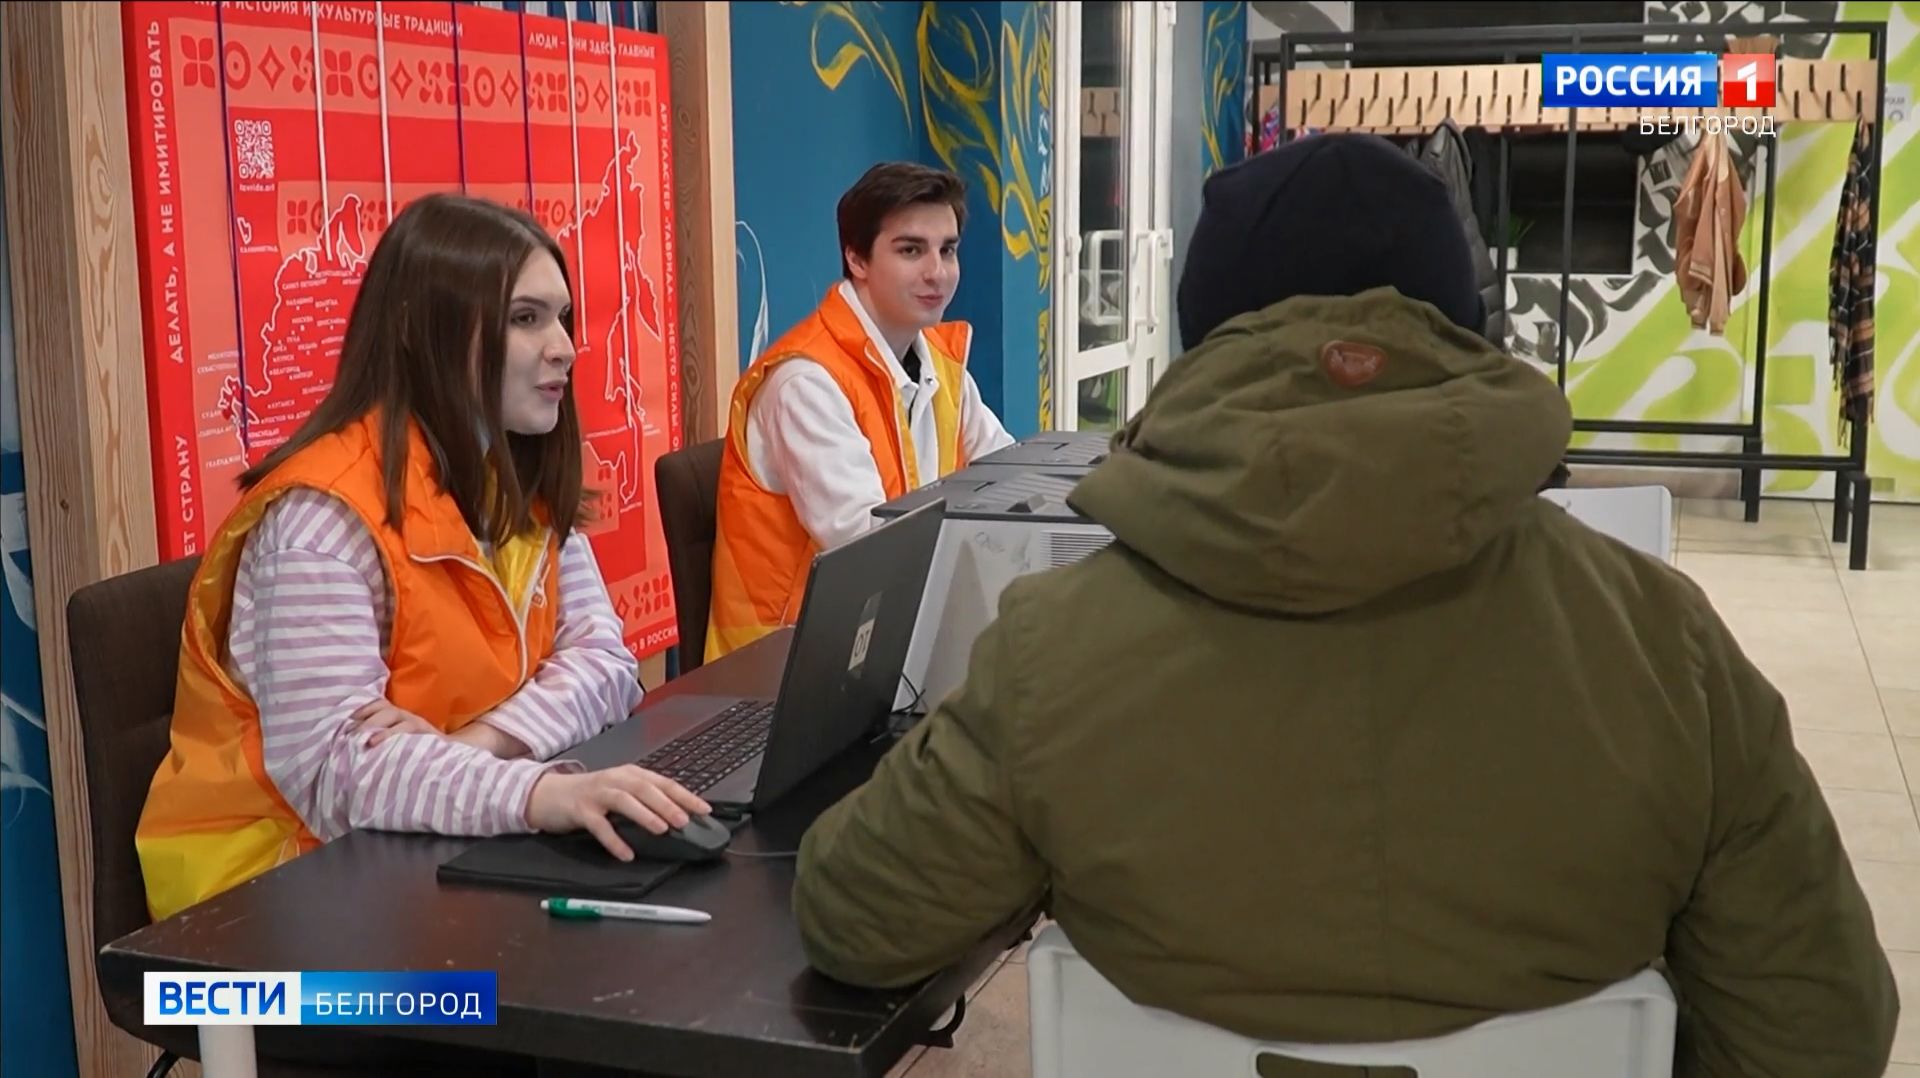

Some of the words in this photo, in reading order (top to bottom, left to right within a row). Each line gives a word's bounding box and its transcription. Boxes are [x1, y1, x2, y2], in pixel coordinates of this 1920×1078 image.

[235, 1, 298, 15] ИСТОРИЯ
[317, 4, 401, 29] КУЛЬТУРЫЕ
[528, 31, 558, 49] ЛЮДИ
[618, 43, 656, 60] ГЛАВНЫЕ
[147, 20, 172, 195] ИМИТИРОВАТЬ
[160, 202, 174, 234] НЕ
[163, 241, 176, 257] А
[668, 322, 678, 377] МЕСТО
[175, 435, 195, 523] СТРАНУ
